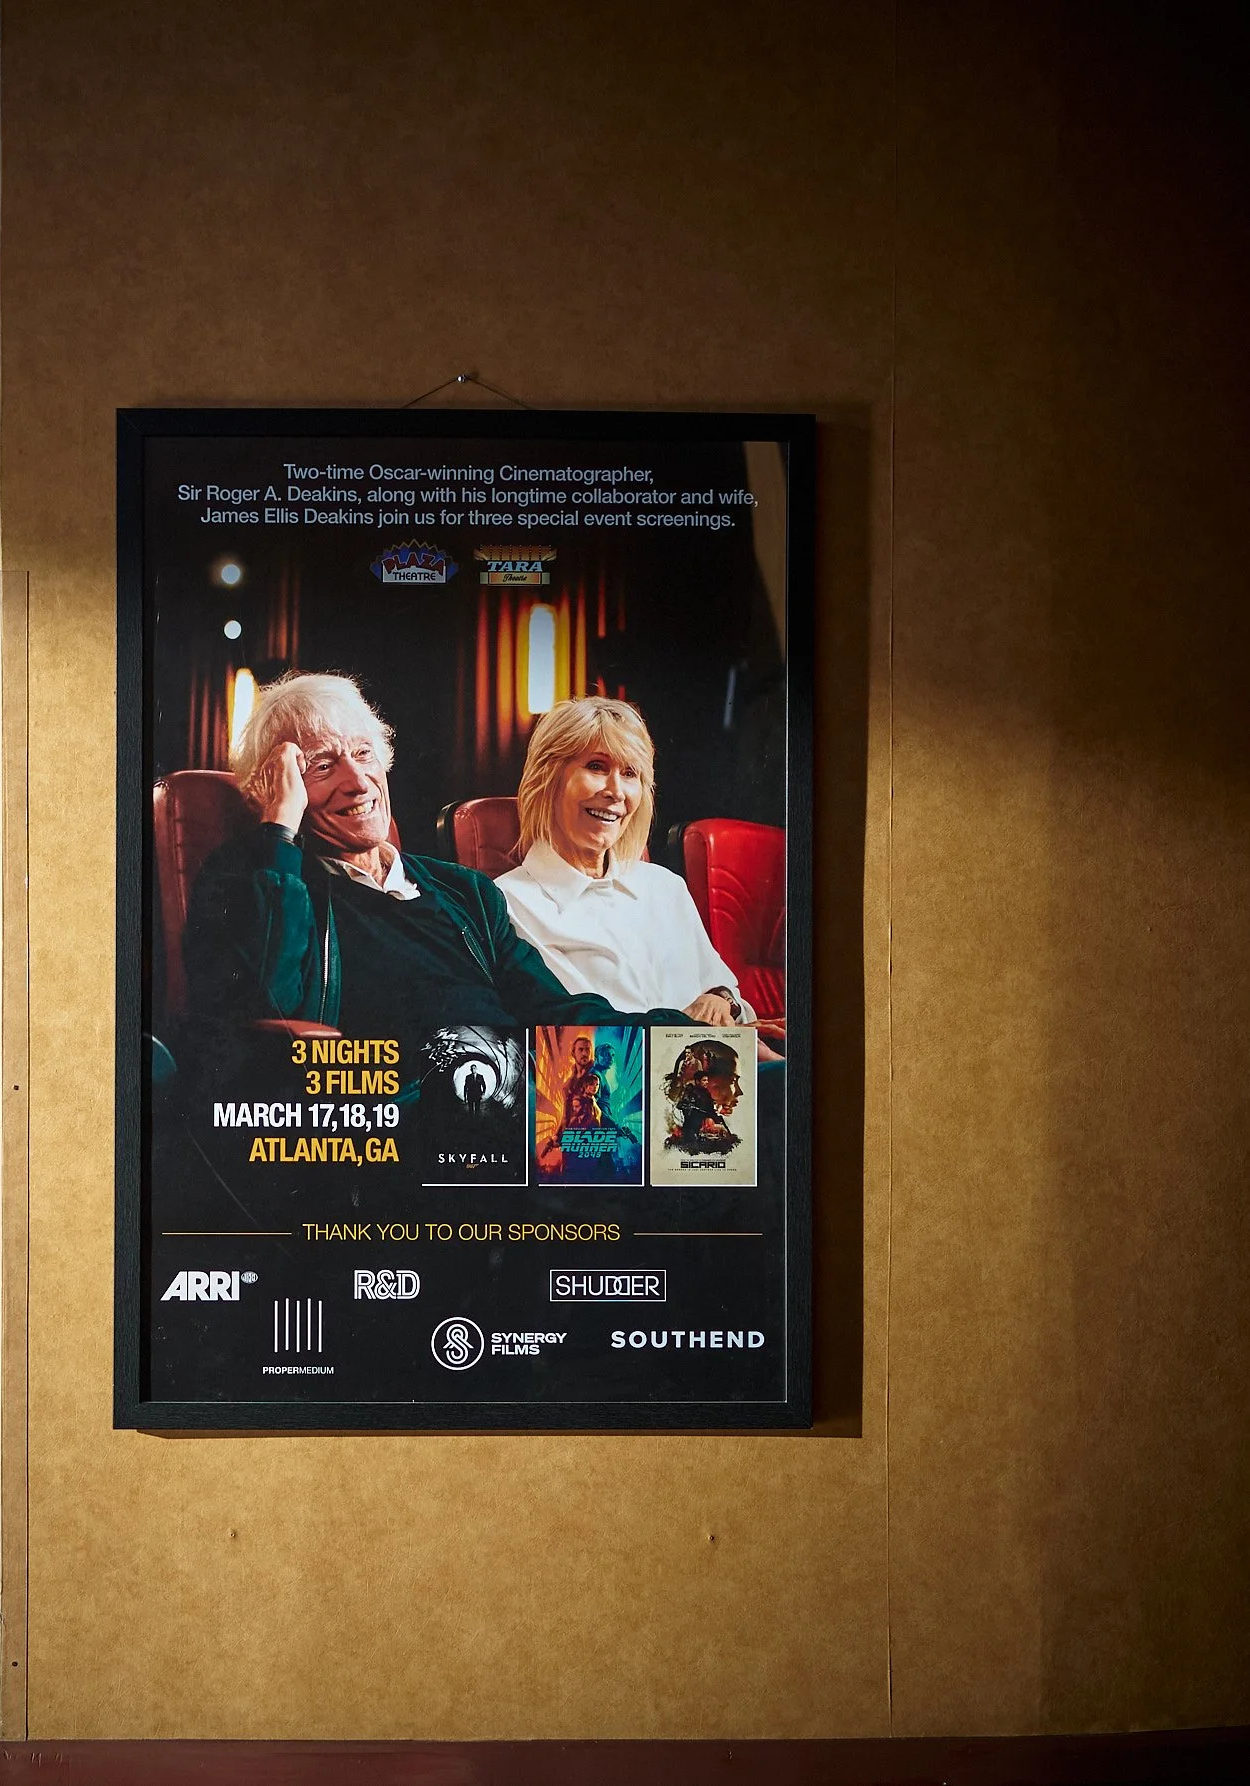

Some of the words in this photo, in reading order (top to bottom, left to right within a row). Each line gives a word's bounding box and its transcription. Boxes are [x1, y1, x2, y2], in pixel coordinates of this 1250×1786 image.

[283, 463, 365, 480] Two-time
[369, 464, 495, 485] Oscar-winning
[499, 465, 654, 486] Cinematographer,
[177, 484, 203, 501] Sir
[206, 485, 261, 507] Roger
[263, 485, 283, 502] A.
[287, 486, 362, 505] Deakins,
[367, 486, 416, 507] along
[420, 487, 456, 503] with
[461, 487, 487, 503] his
[491, 487, 567, 507] longtime
[571, 488, 677, 505] collaborator
[680, 489, 714, 505] and
[718, 489, 759, 508] wife,
[200, 507, 260, 524] James
[264, 507, 299, 524] Ellis
[304, 508, 375, 525] Deakins
[377, 508, 409, 529] join
[414, 512, 435, 526] us
[439, 509, 465, 526] for
[467, 509, 513, 526] three
[517, 509, 579, 530] special
[584, 511, 632, 527] event
[636, 511, 736, 531] screenings.
[382, 552, 445, 576] PLAZA
[487, 560, 543, 572] TARA
[392, 571, 436, 581] THEATRE
[291, 1039, 307, 1064] 3
[311, 1039, 400, 1065] NIGHTS
[305, 1070, 321, 1095] 3
[326, 1070, 400, 1095] FILMS
[213, 1102, 302, 1128] MARCH
[307, 1103, 400, 1132] 17,18,19
[561, 1130, 618, 1143] BLADE
[437, 1153, 509, 1164] SKYFALL
[302, 1223, 372, 1242] THANK
[376, 1223, 419, 1242] YOU
[424, 1223, 453, 1242] TO
[458, 1223, 502, 1242] OUR
[508, 1223, 621, 1242] SPONSORS
[160, 1270, 240, 1301] ARRI
[353, 1269, 421, 1300] R&D
[555, 1275, 660, 1297] SHUDDER
[490, 1332, 568, 1344] SYNERGY
[610, 1330, 765, 1349] SOUTHEND
[491, 1344, 541, 1356] FILMS
